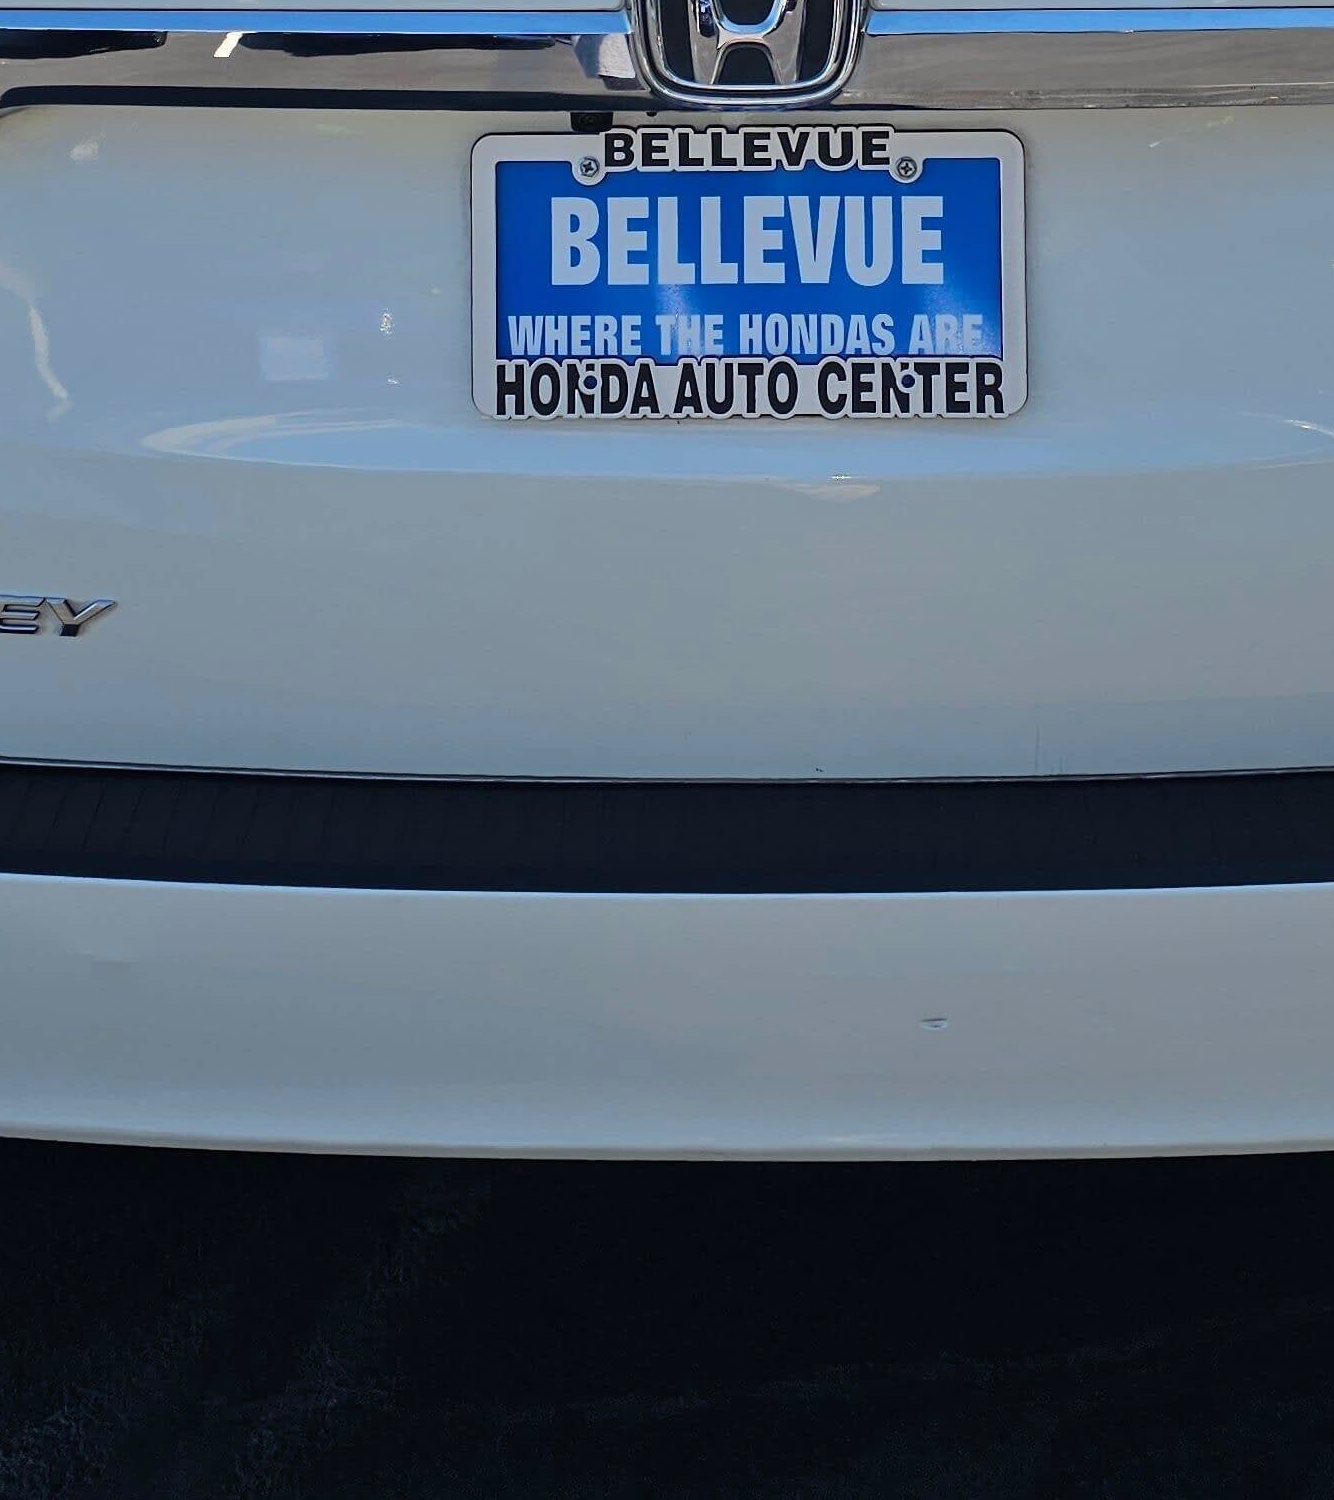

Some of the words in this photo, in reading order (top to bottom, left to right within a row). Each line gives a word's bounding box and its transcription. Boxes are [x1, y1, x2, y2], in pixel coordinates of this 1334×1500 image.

[604, 130, 890, 167] BELLEVUE
[551, 195, 944, 286] BELLEVUE
[508, 315, 642, 355] WHERE
[655, 315, 725, 355] THE
[740, 313, 895, 355] HONDAS
[910, 314, 982, 355] ARE
[496, 362, 660, 416] HONDA
[673, 360, 800, 415] AUTO
[816, 361, 1004, 415] CENTER
